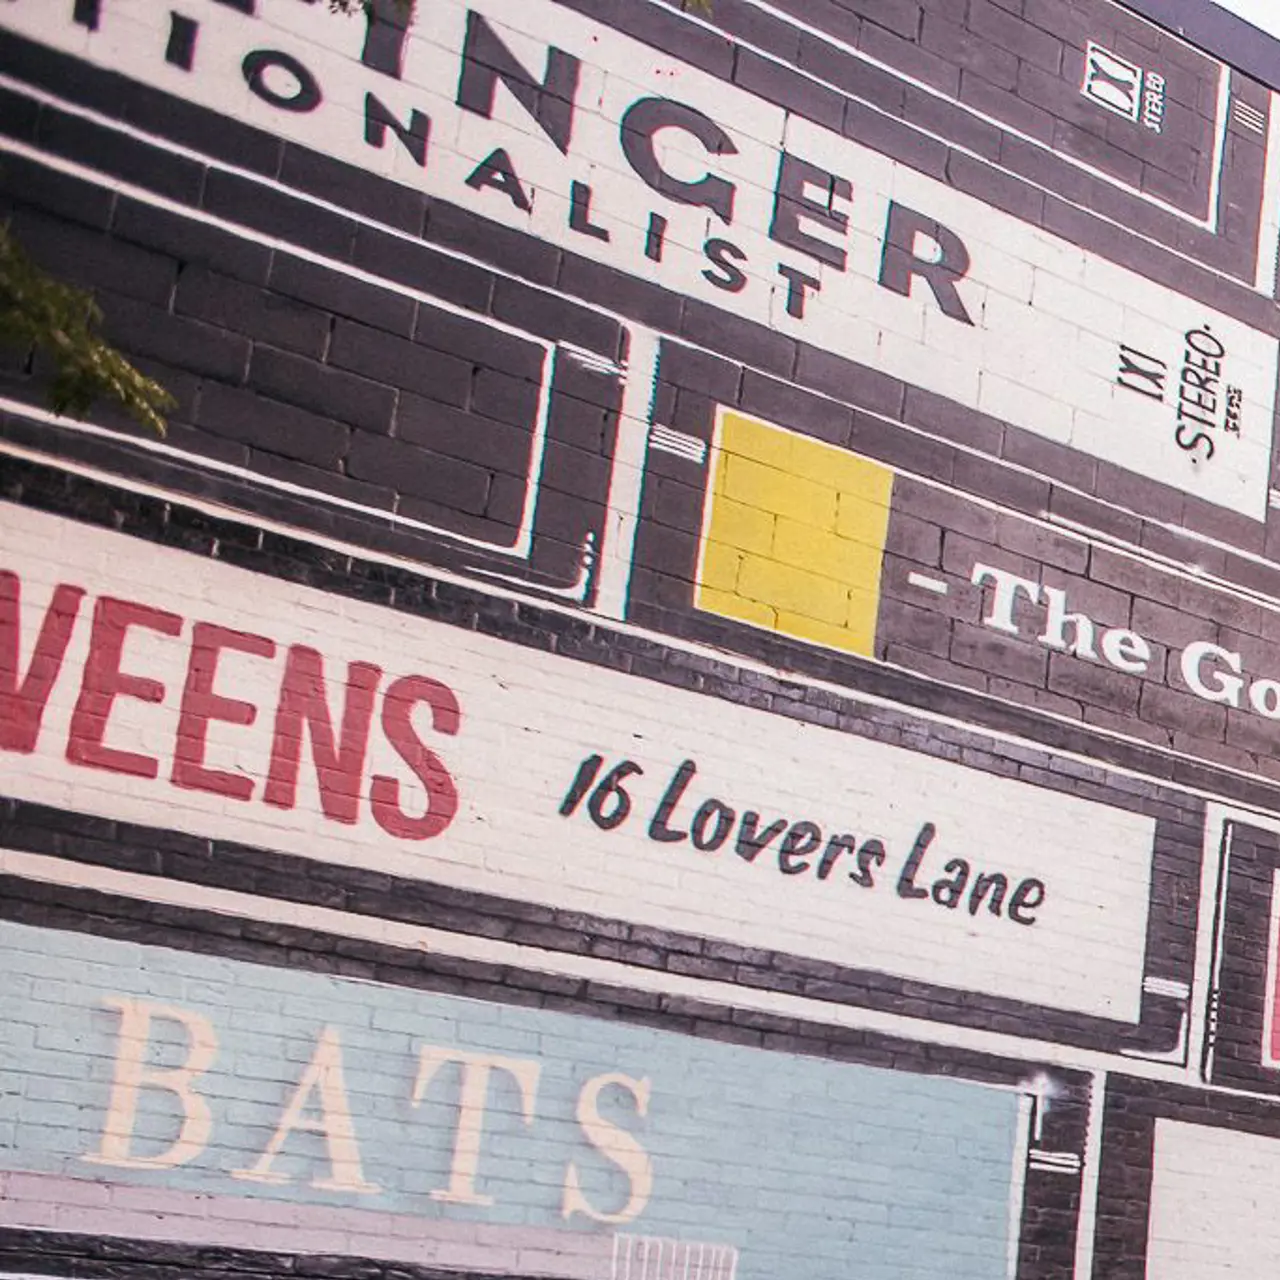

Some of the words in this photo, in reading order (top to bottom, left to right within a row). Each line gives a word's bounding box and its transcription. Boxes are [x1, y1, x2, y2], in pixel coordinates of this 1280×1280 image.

[970, 562, 1152, 673] The
[556, 752, 641, 833] 16
[647, 758, 887, 890] Lovers
[896, 822, 1046, 926] Lane
[78, 996, 655, 1226] BATS
